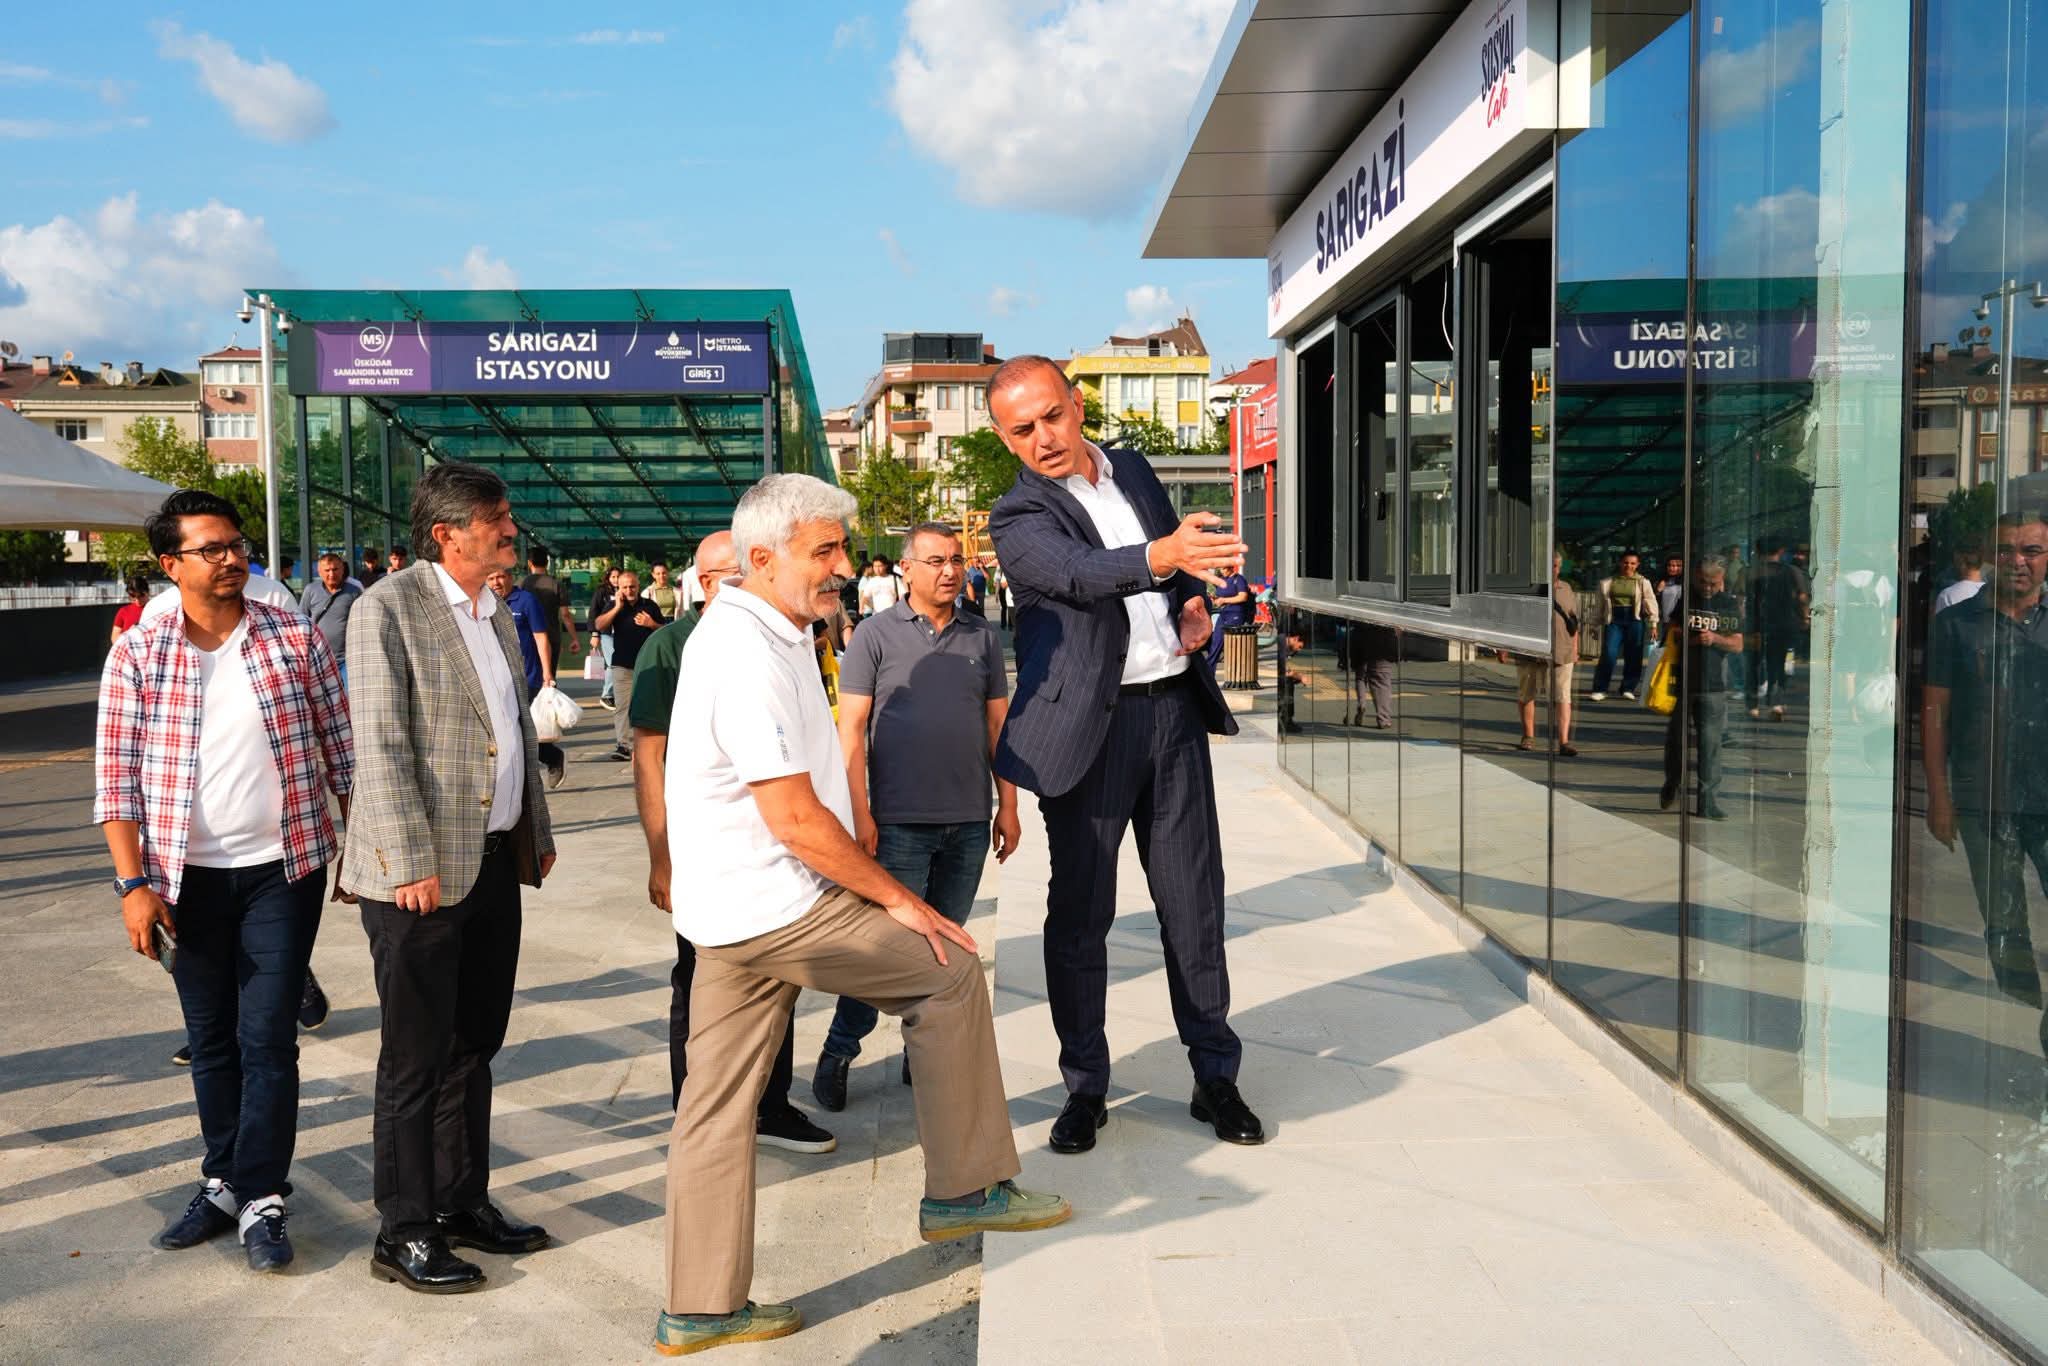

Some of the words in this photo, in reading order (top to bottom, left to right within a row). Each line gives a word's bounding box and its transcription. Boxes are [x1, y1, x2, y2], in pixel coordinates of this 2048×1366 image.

[1481, 13, 1515, 103] SOSYAL
[1316, 98, 1406, 275] SARIGAZİ
[362, 333, 384, 346] M5
[488, 328, 597, 352] SARIGAZİ
[354, 357, 392, 367] ÜSKÜDAR
[476, 356, 610, 380] İSTASYONU
[382, 368, 414, 377] MERKEZ
[688, 367, 712, 380] GİRİŞ
[348, 377, 376, 386] METRO
[377, 377, 400, 386] HATTI
